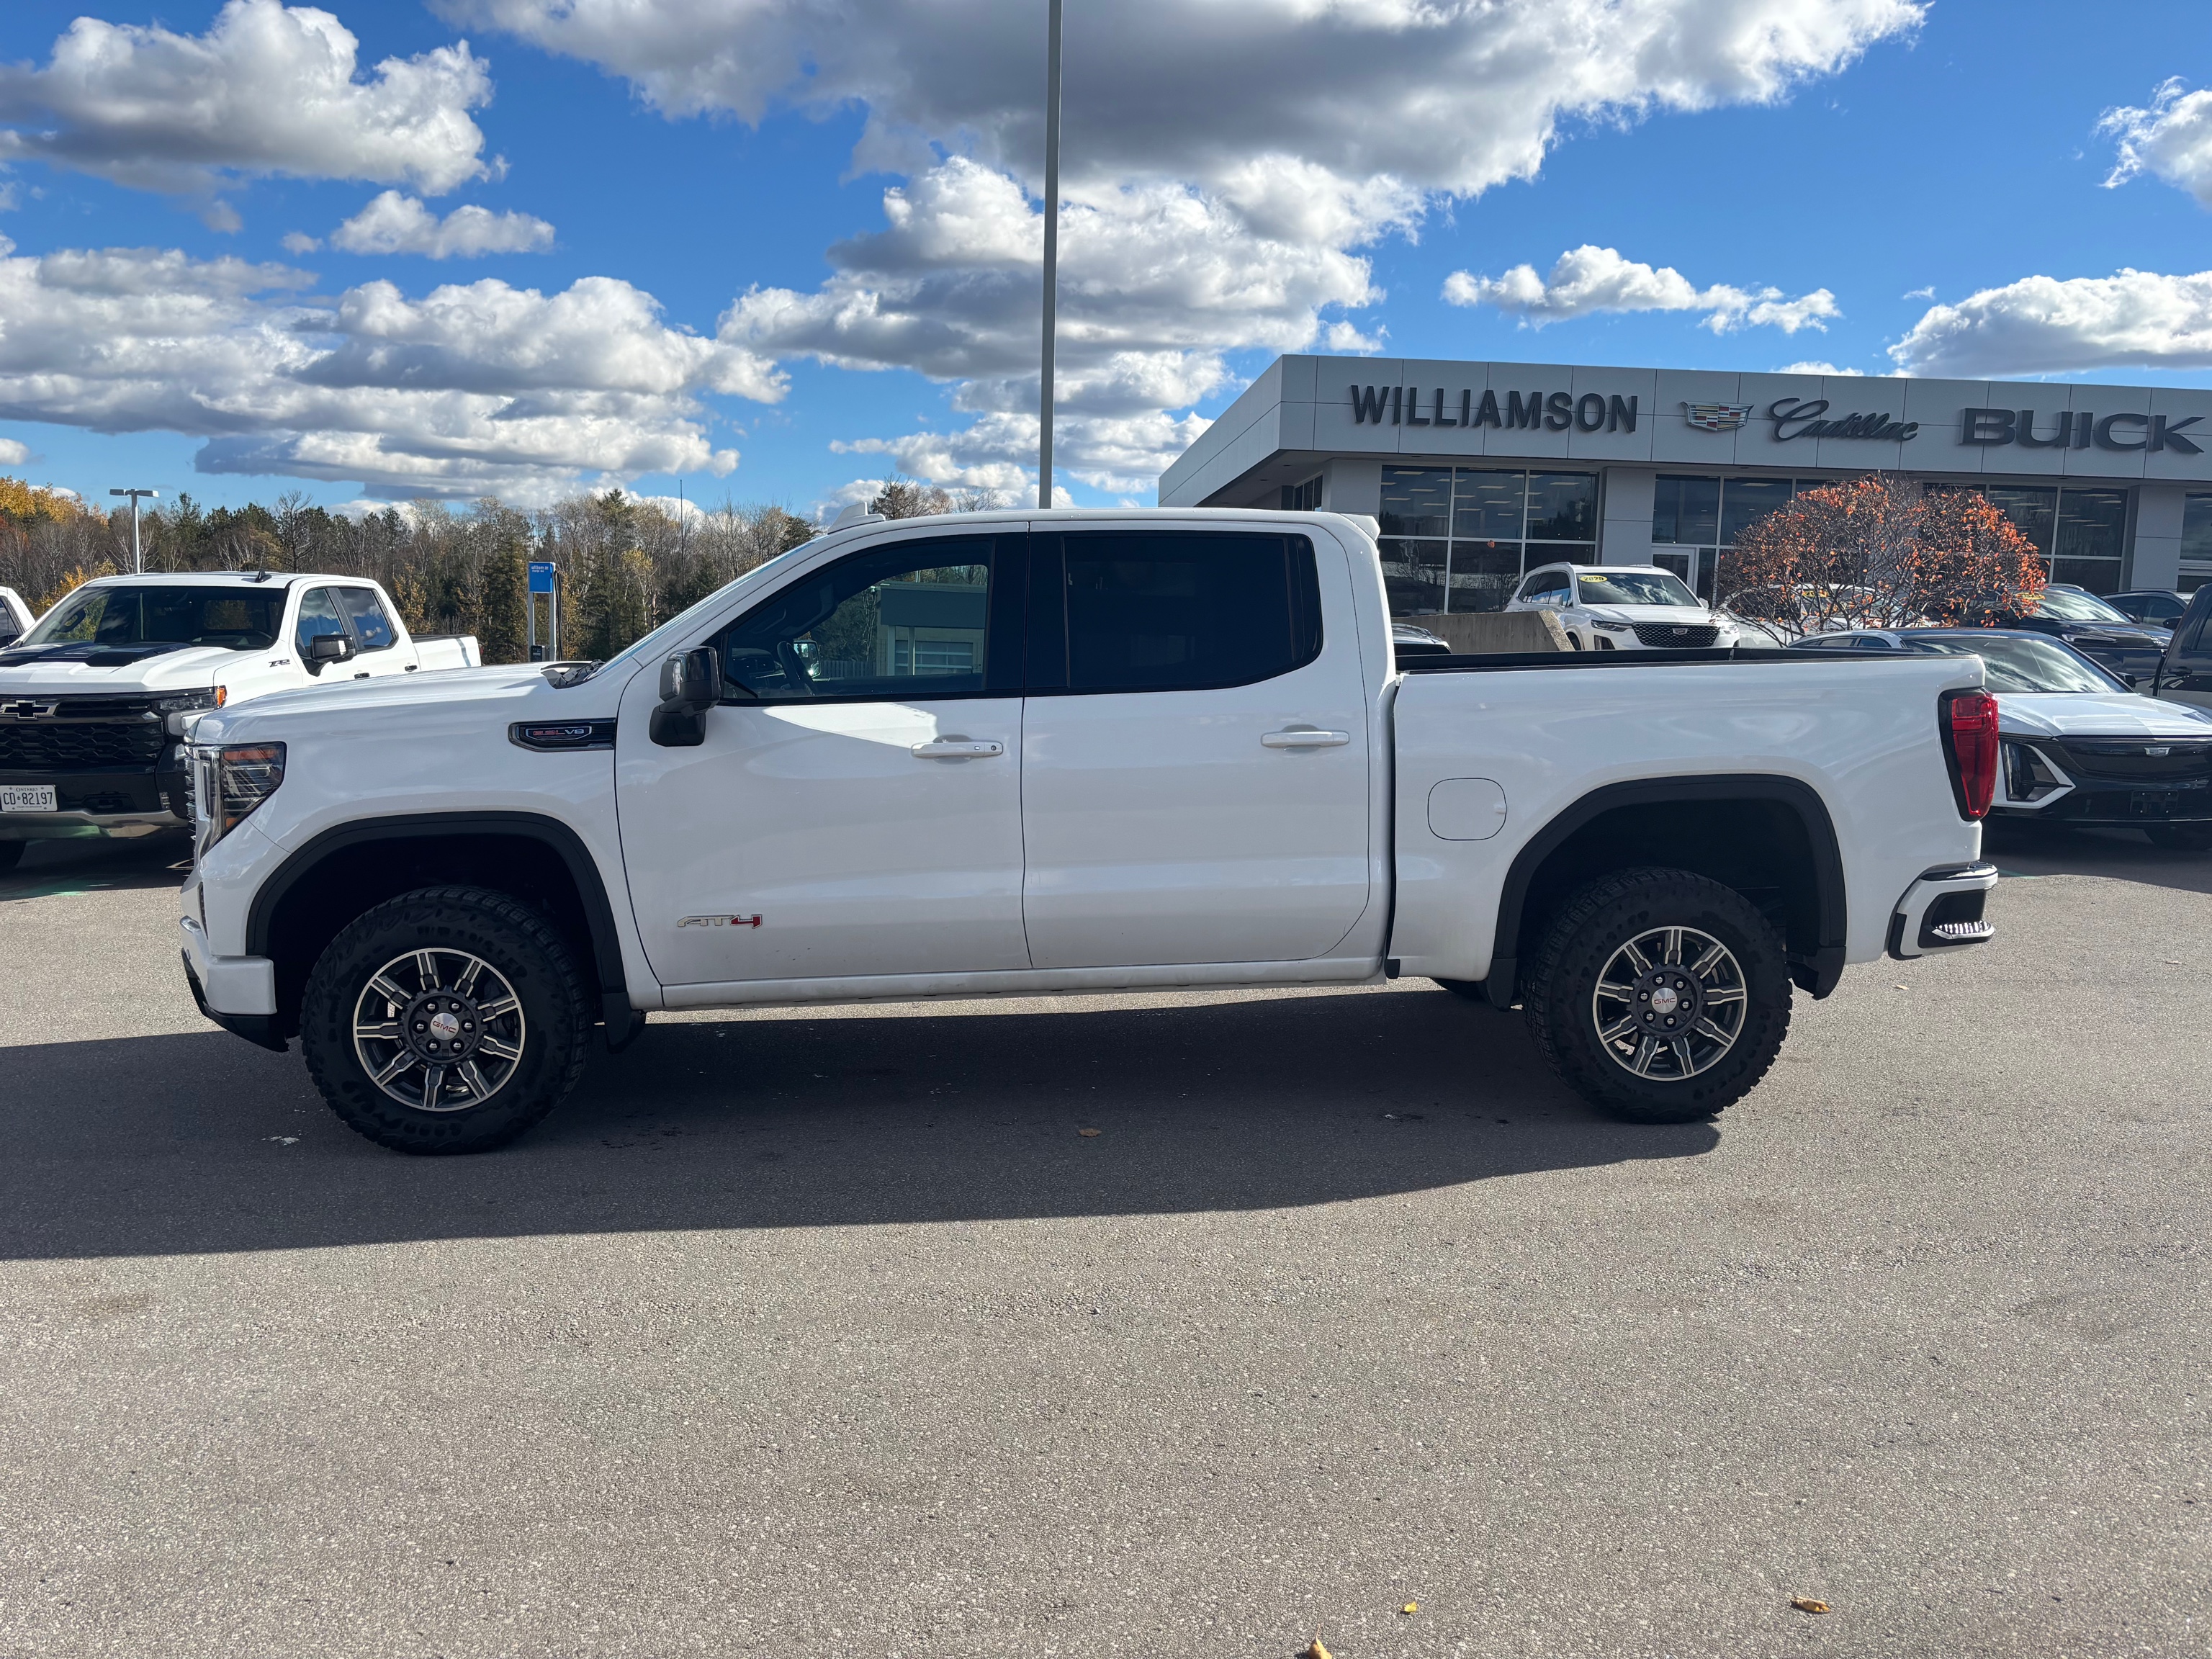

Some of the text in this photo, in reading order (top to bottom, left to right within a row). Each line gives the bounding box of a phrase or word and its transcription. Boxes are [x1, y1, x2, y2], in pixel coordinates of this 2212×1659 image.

[1351, 385, 2206, 454] WILLIAMSON Cadillac BUICK
[677, 914, 763, 930] AT4
[433, 1020, 457, 1034] GMC
